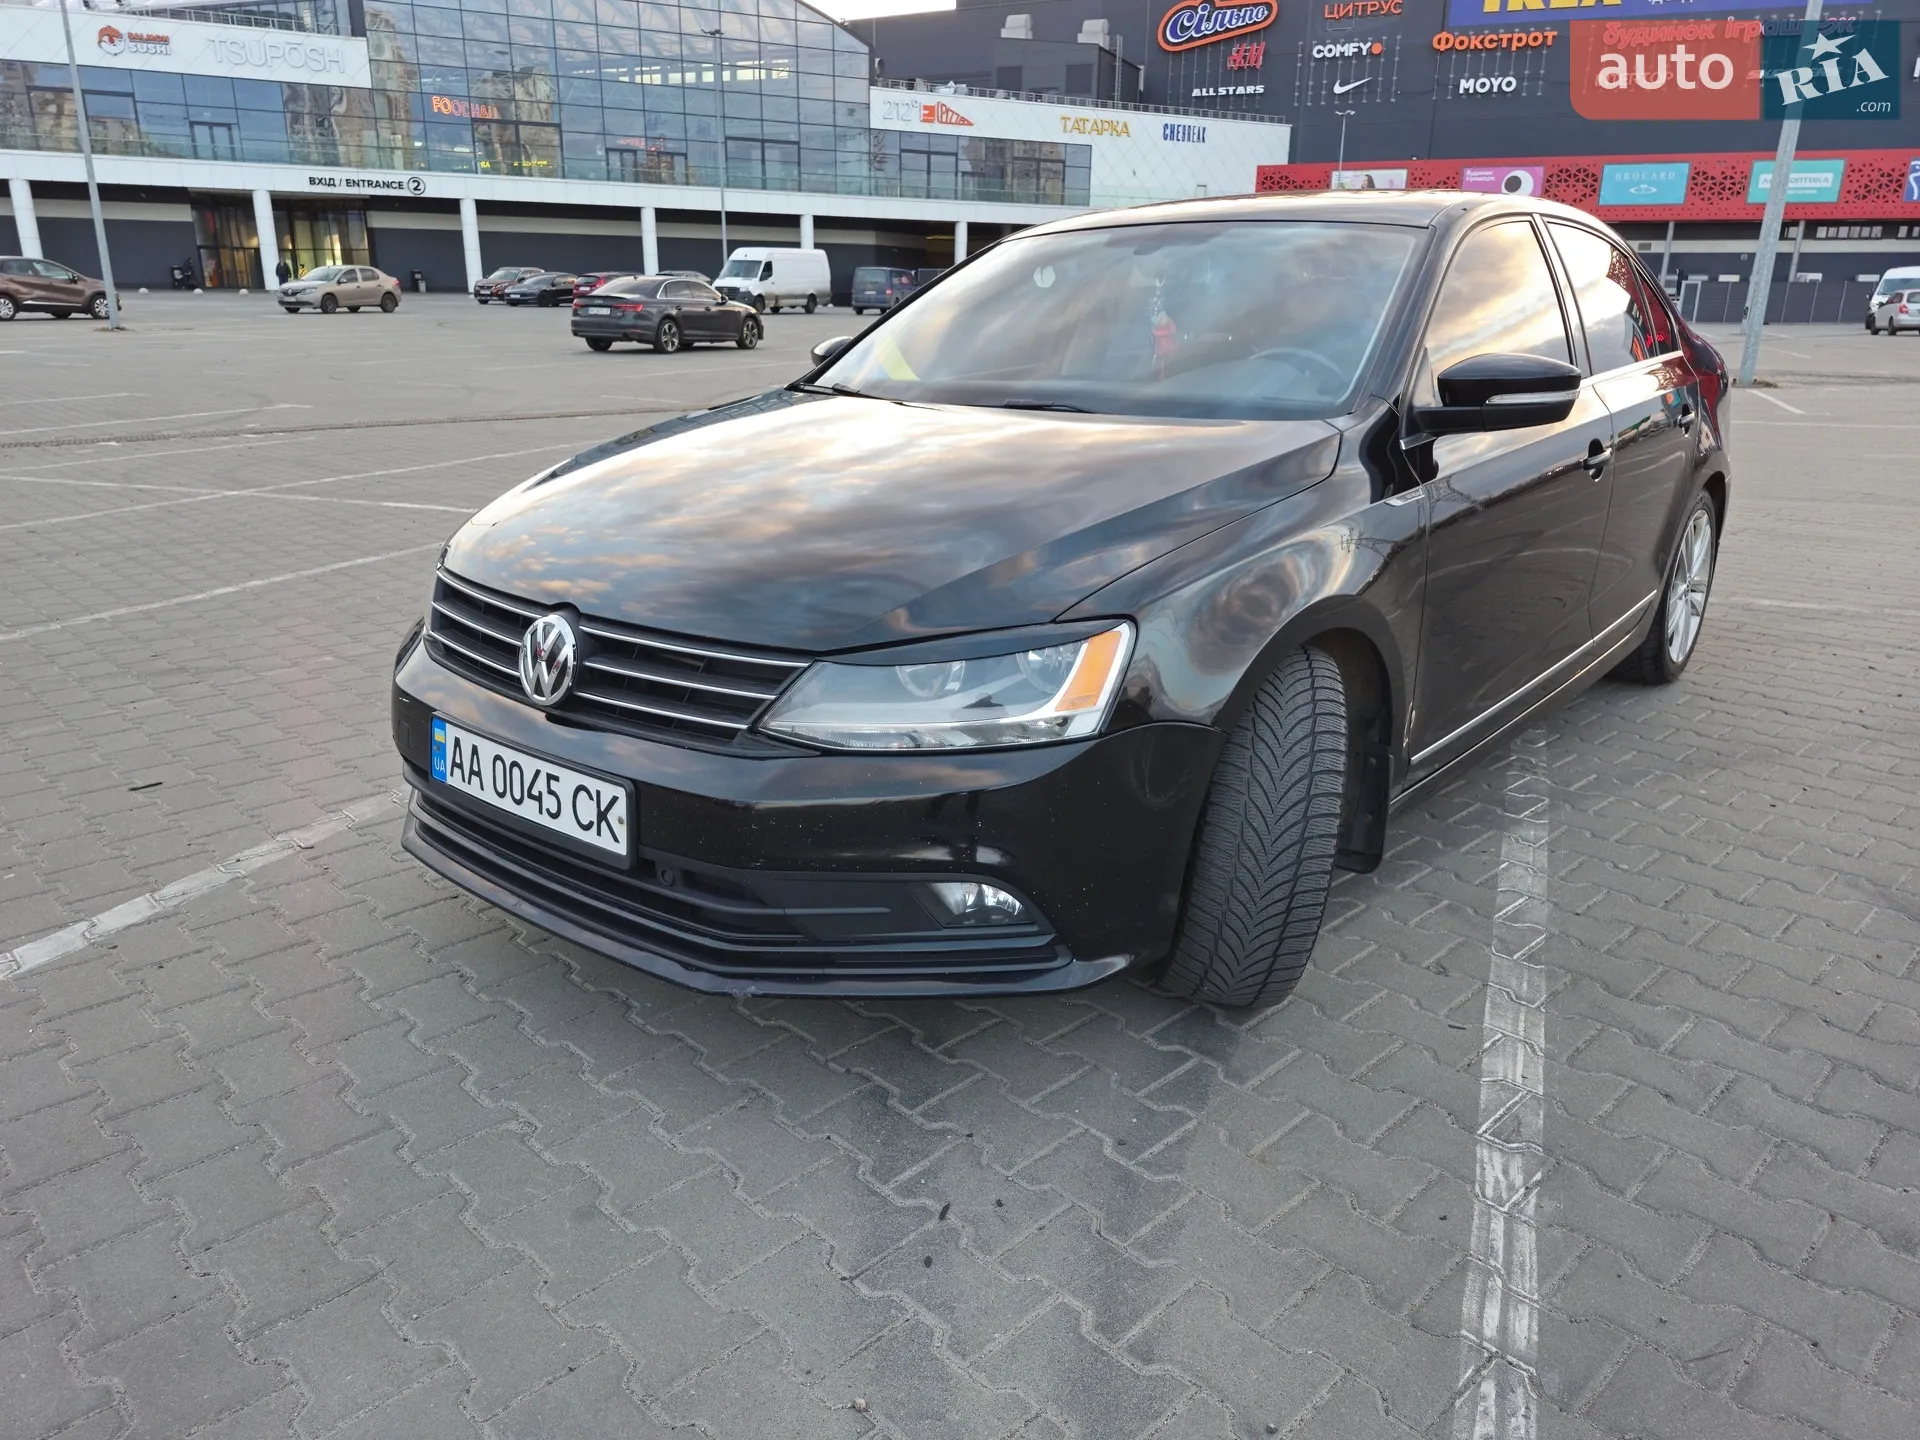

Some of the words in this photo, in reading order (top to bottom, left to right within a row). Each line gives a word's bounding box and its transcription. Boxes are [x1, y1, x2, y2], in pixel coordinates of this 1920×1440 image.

[1324, 0, 1403, 20] ЦИТРУС
[1165, 3, 1268, 43] Сільпо
[127, 42, 172, 55] SUSHI
[1312, 42, 1372, 58] COMFY
[1432, 31, 1558, 52] Фокстрот
[1192, 88, 1217, 97] ALL
[1217, 85, 1265, 95] STARS
[1459, 76, 1517, 94] MOYO
[1061, 115, 1131, 137] ТАТАРКА
[1163, 123, 1207, 143] CHEBREAK
[309, 176, 336, 187] ВХІД
[345, 178, 404, 190] ENTRANCE
[1615, 171, 1676, 181] BROCARD
[434, 756, 446, 774] UA
[450, 736, 484, 791] AA
[492, 754, 561, 820] 0045
[572, 784, 621, 844] CK
